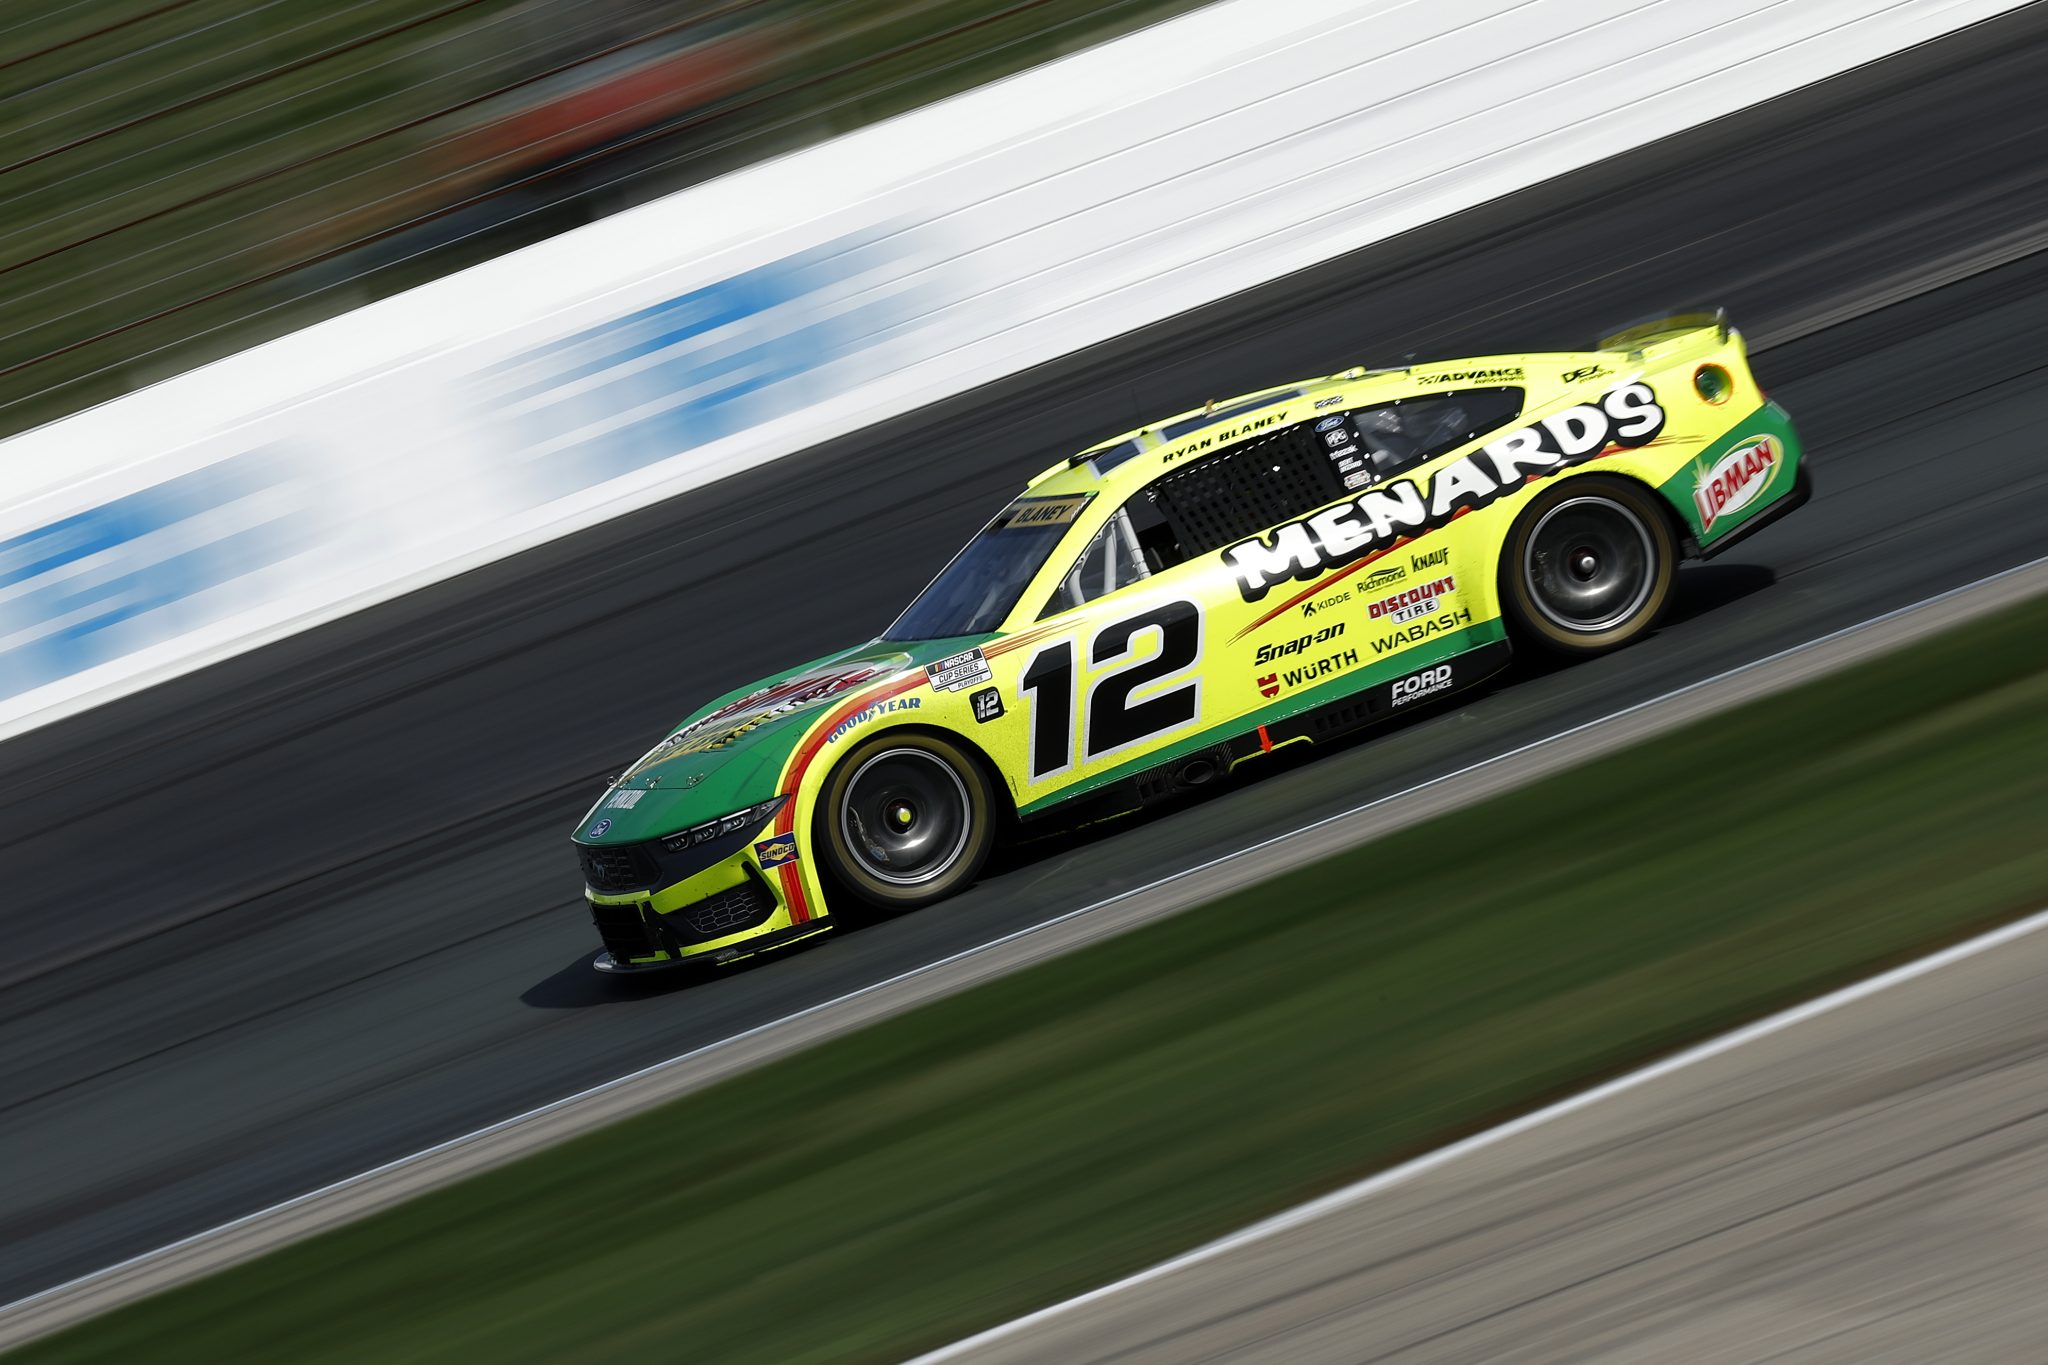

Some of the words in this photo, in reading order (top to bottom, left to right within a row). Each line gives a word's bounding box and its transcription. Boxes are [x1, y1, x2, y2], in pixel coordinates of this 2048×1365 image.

[1439, 367, 1524, 382] ADVANCE
[1163, 438, 1212, 463] RYAN
[1219, 411, 1288, 442] BLANEY
[1222, 382, 1666, 603] MENARDS
[1693, 437, 1776, 531] LIBMAN
[1015, 504, 1073, 523] BLANEY
[1411, 547, 1449, 572] KNAUF
[1357, 566, 1406, 593] Richmond
[1317, 592, 1351, 611] KIDDE
[1367, 575, 1456, 620] DISCOUNT
[1396, 601, 1435, 620] TIRE
[1254, 623, 1345, 666] Snap-on
[1371, 608, 1472, 654] WABASH
[939, 672, 953, 683] CUP
[954, 663, 979, 678] SERIES
[944, 652, 974, 669] NASCAR
[1283, 649, 1359, 687] WÜRTH
[957, 675, 983, 688] PLAYOFFS
[1018, 597, 1204, 785] 12
[1392, 664, 1452, 700] FORD
[1392, 678, 1452, 708] PERFORMANCE
[977, 691, 999, 718] 12
[828, 697, 921, 743] GOODYEAR
[760, 843, 795, 861] SUNOCO
